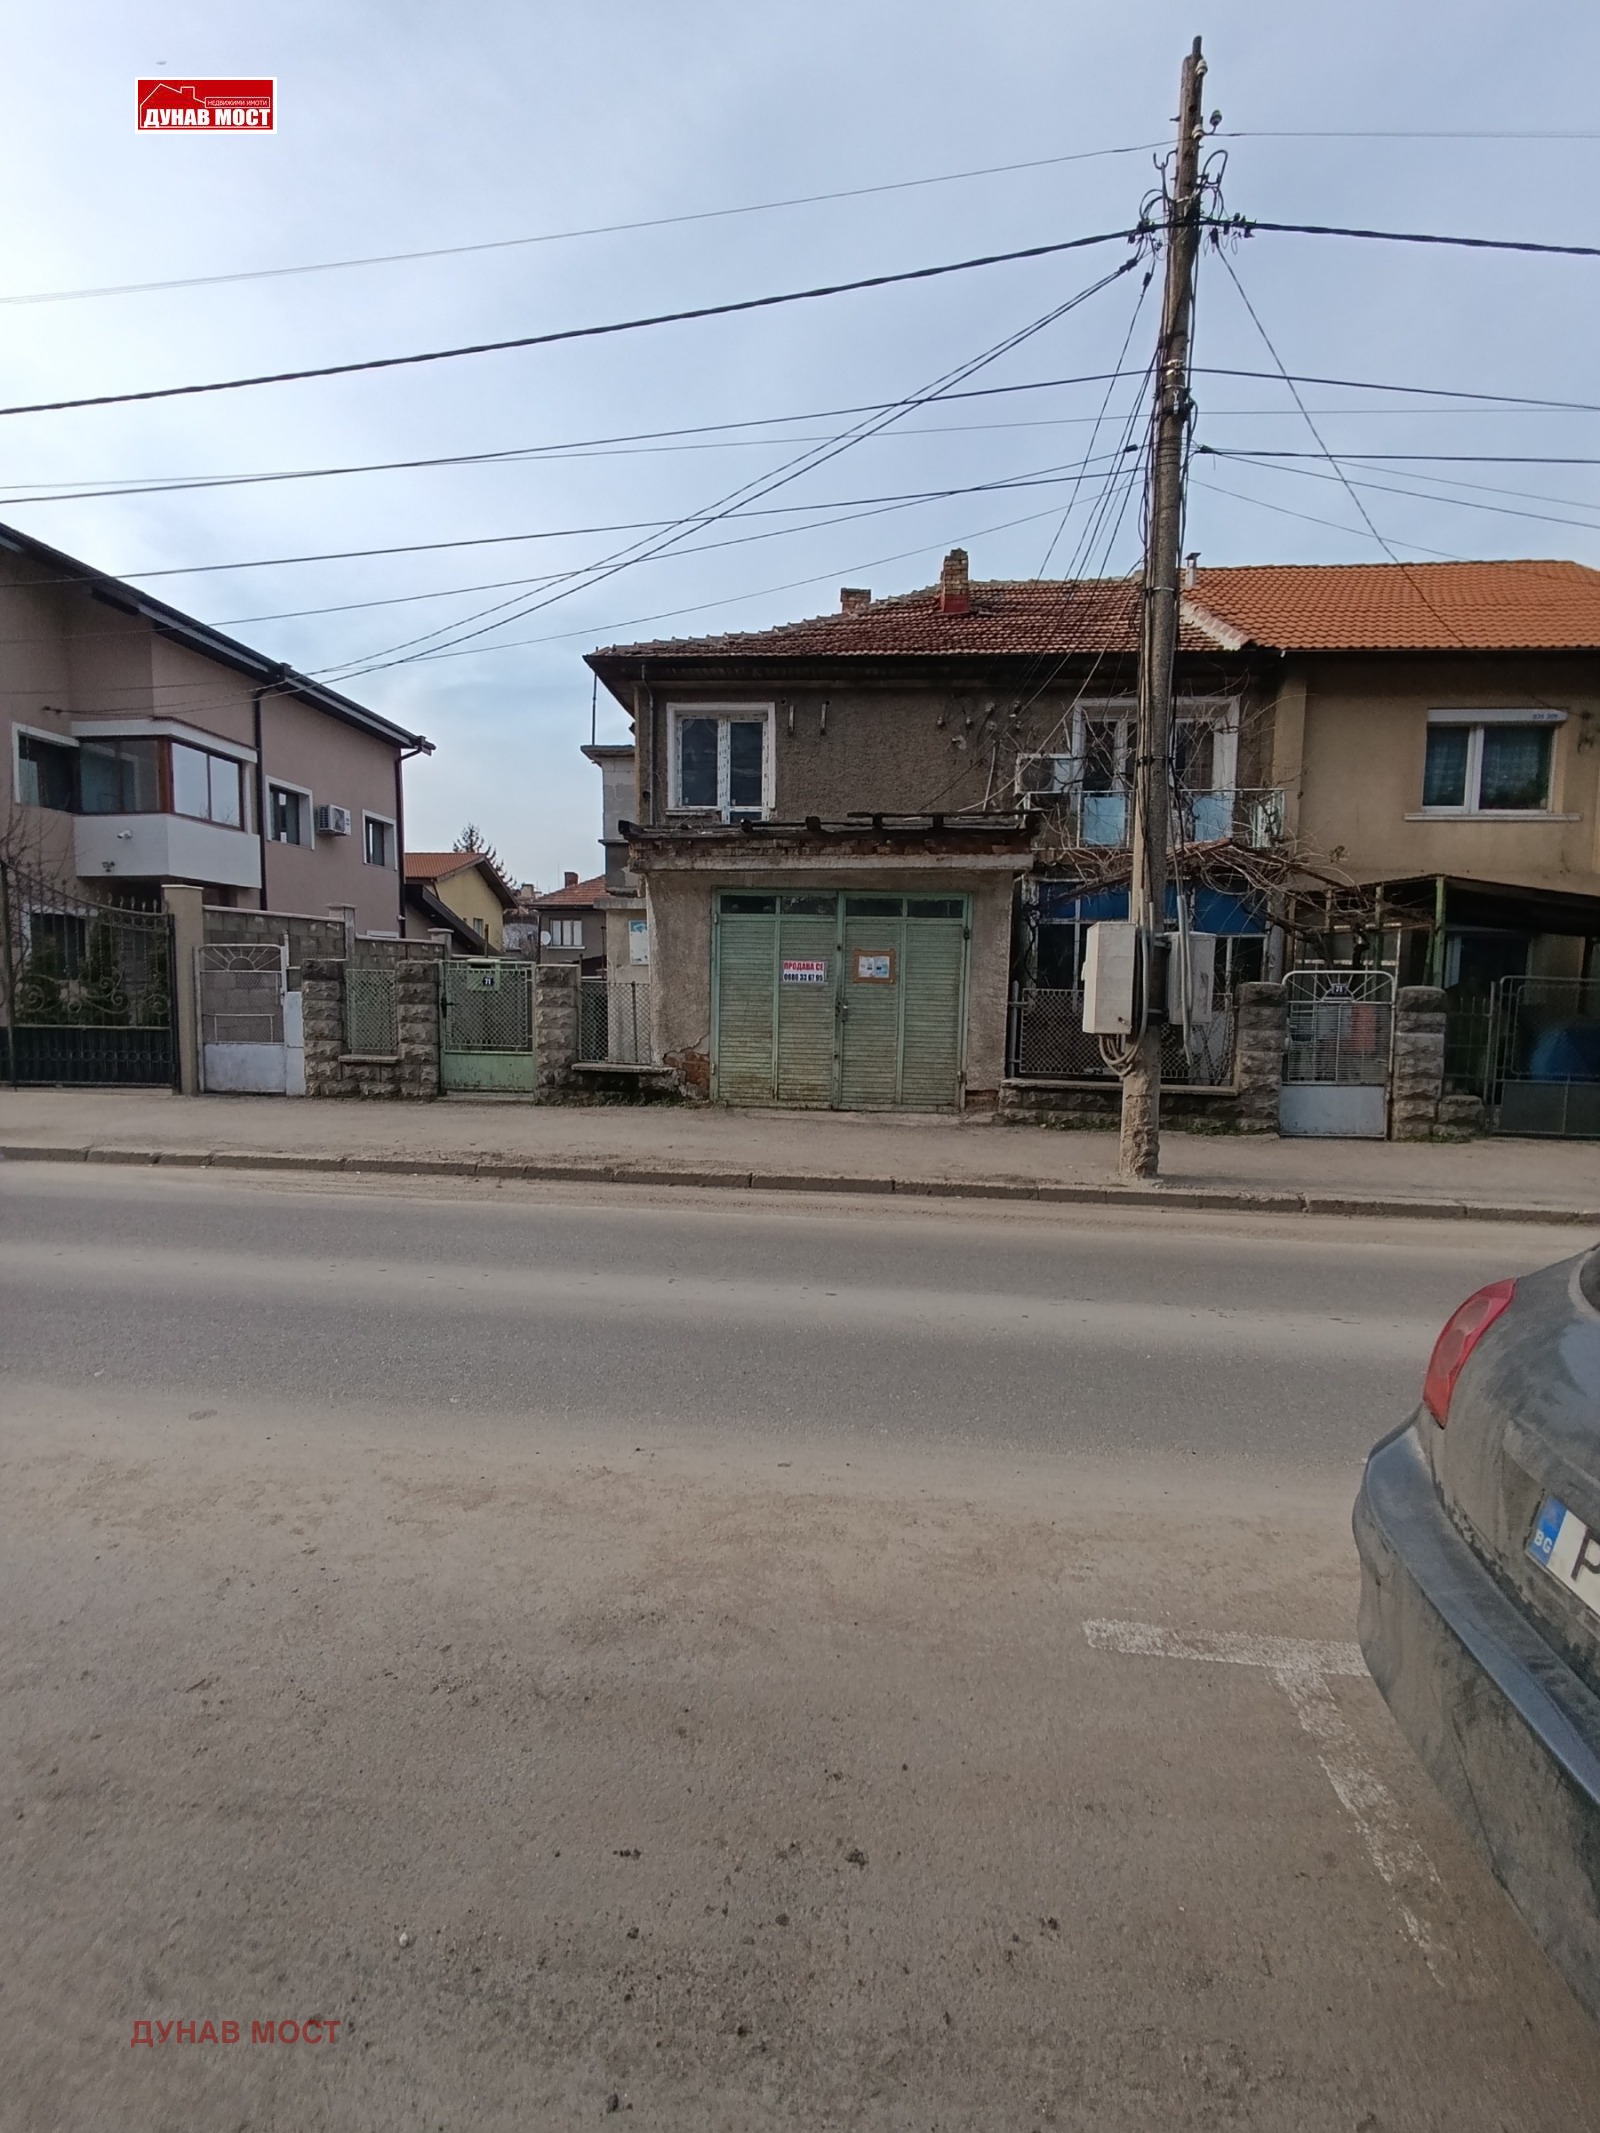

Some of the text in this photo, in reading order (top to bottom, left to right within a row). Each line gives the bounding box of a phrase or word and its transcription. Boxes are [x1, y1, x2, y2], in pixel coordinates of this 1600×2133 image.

[784, 962, 824, 971] ПРОДАВА СЕ
[1534, 1529, 1553, 1553] BG
